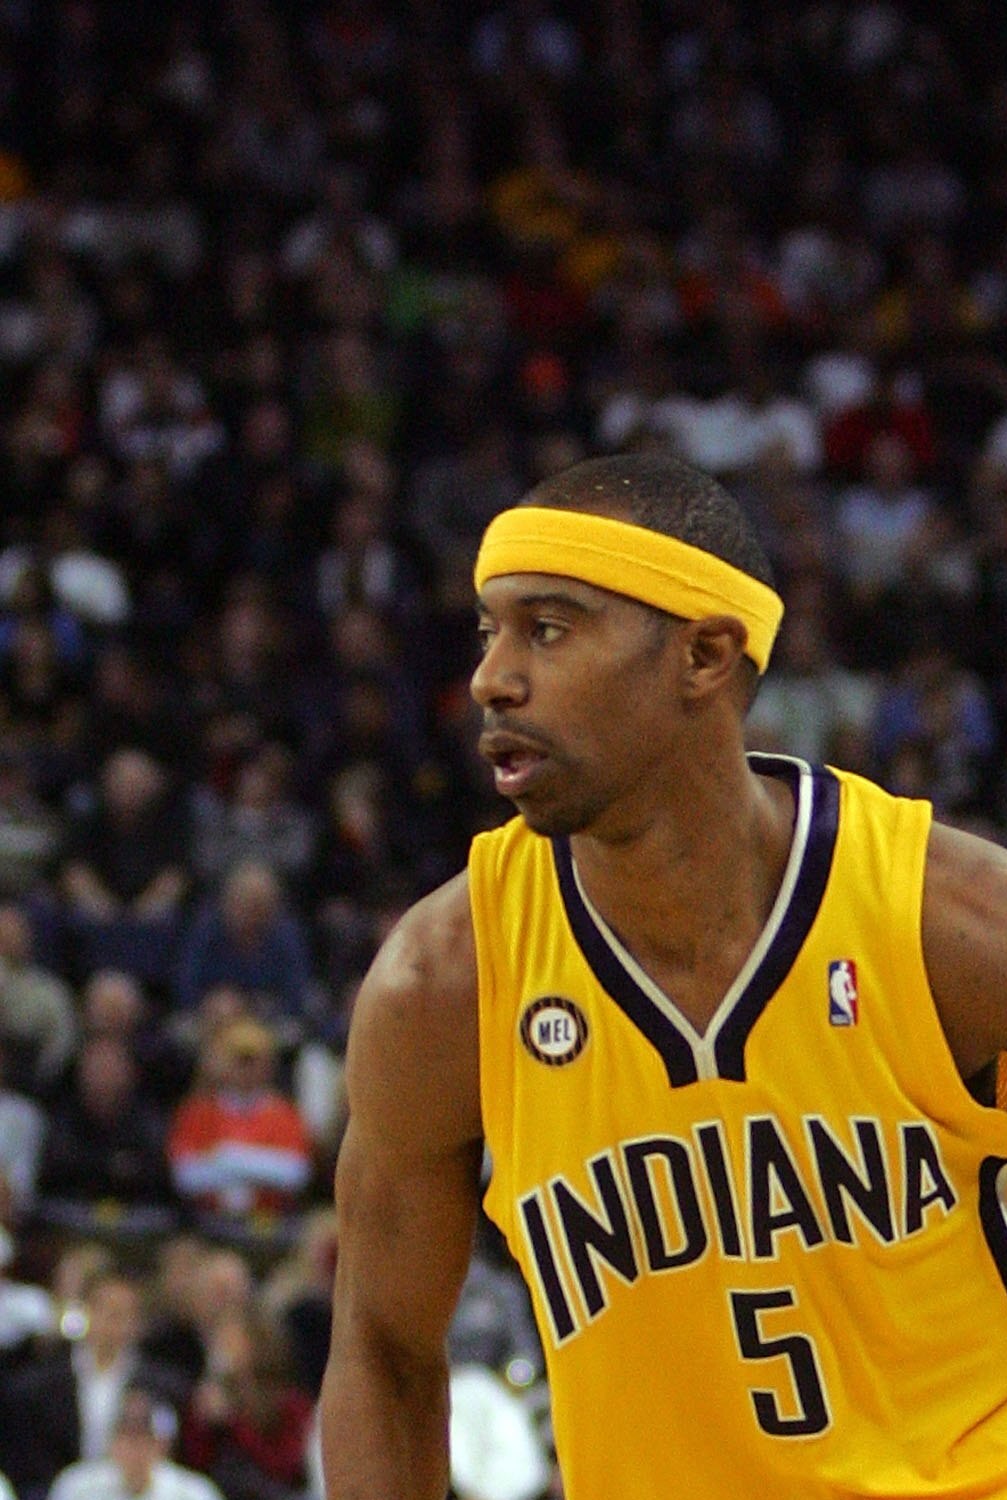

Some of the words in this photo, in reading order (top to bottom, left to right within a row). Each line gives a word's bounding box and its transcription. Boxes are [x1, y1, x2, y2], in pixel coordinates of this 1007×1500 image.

[538, 1017, 572, 1044] MEL
[517, 1114, 959, 1349] INDIANA
[726, 1284, 833, 1442] 5
